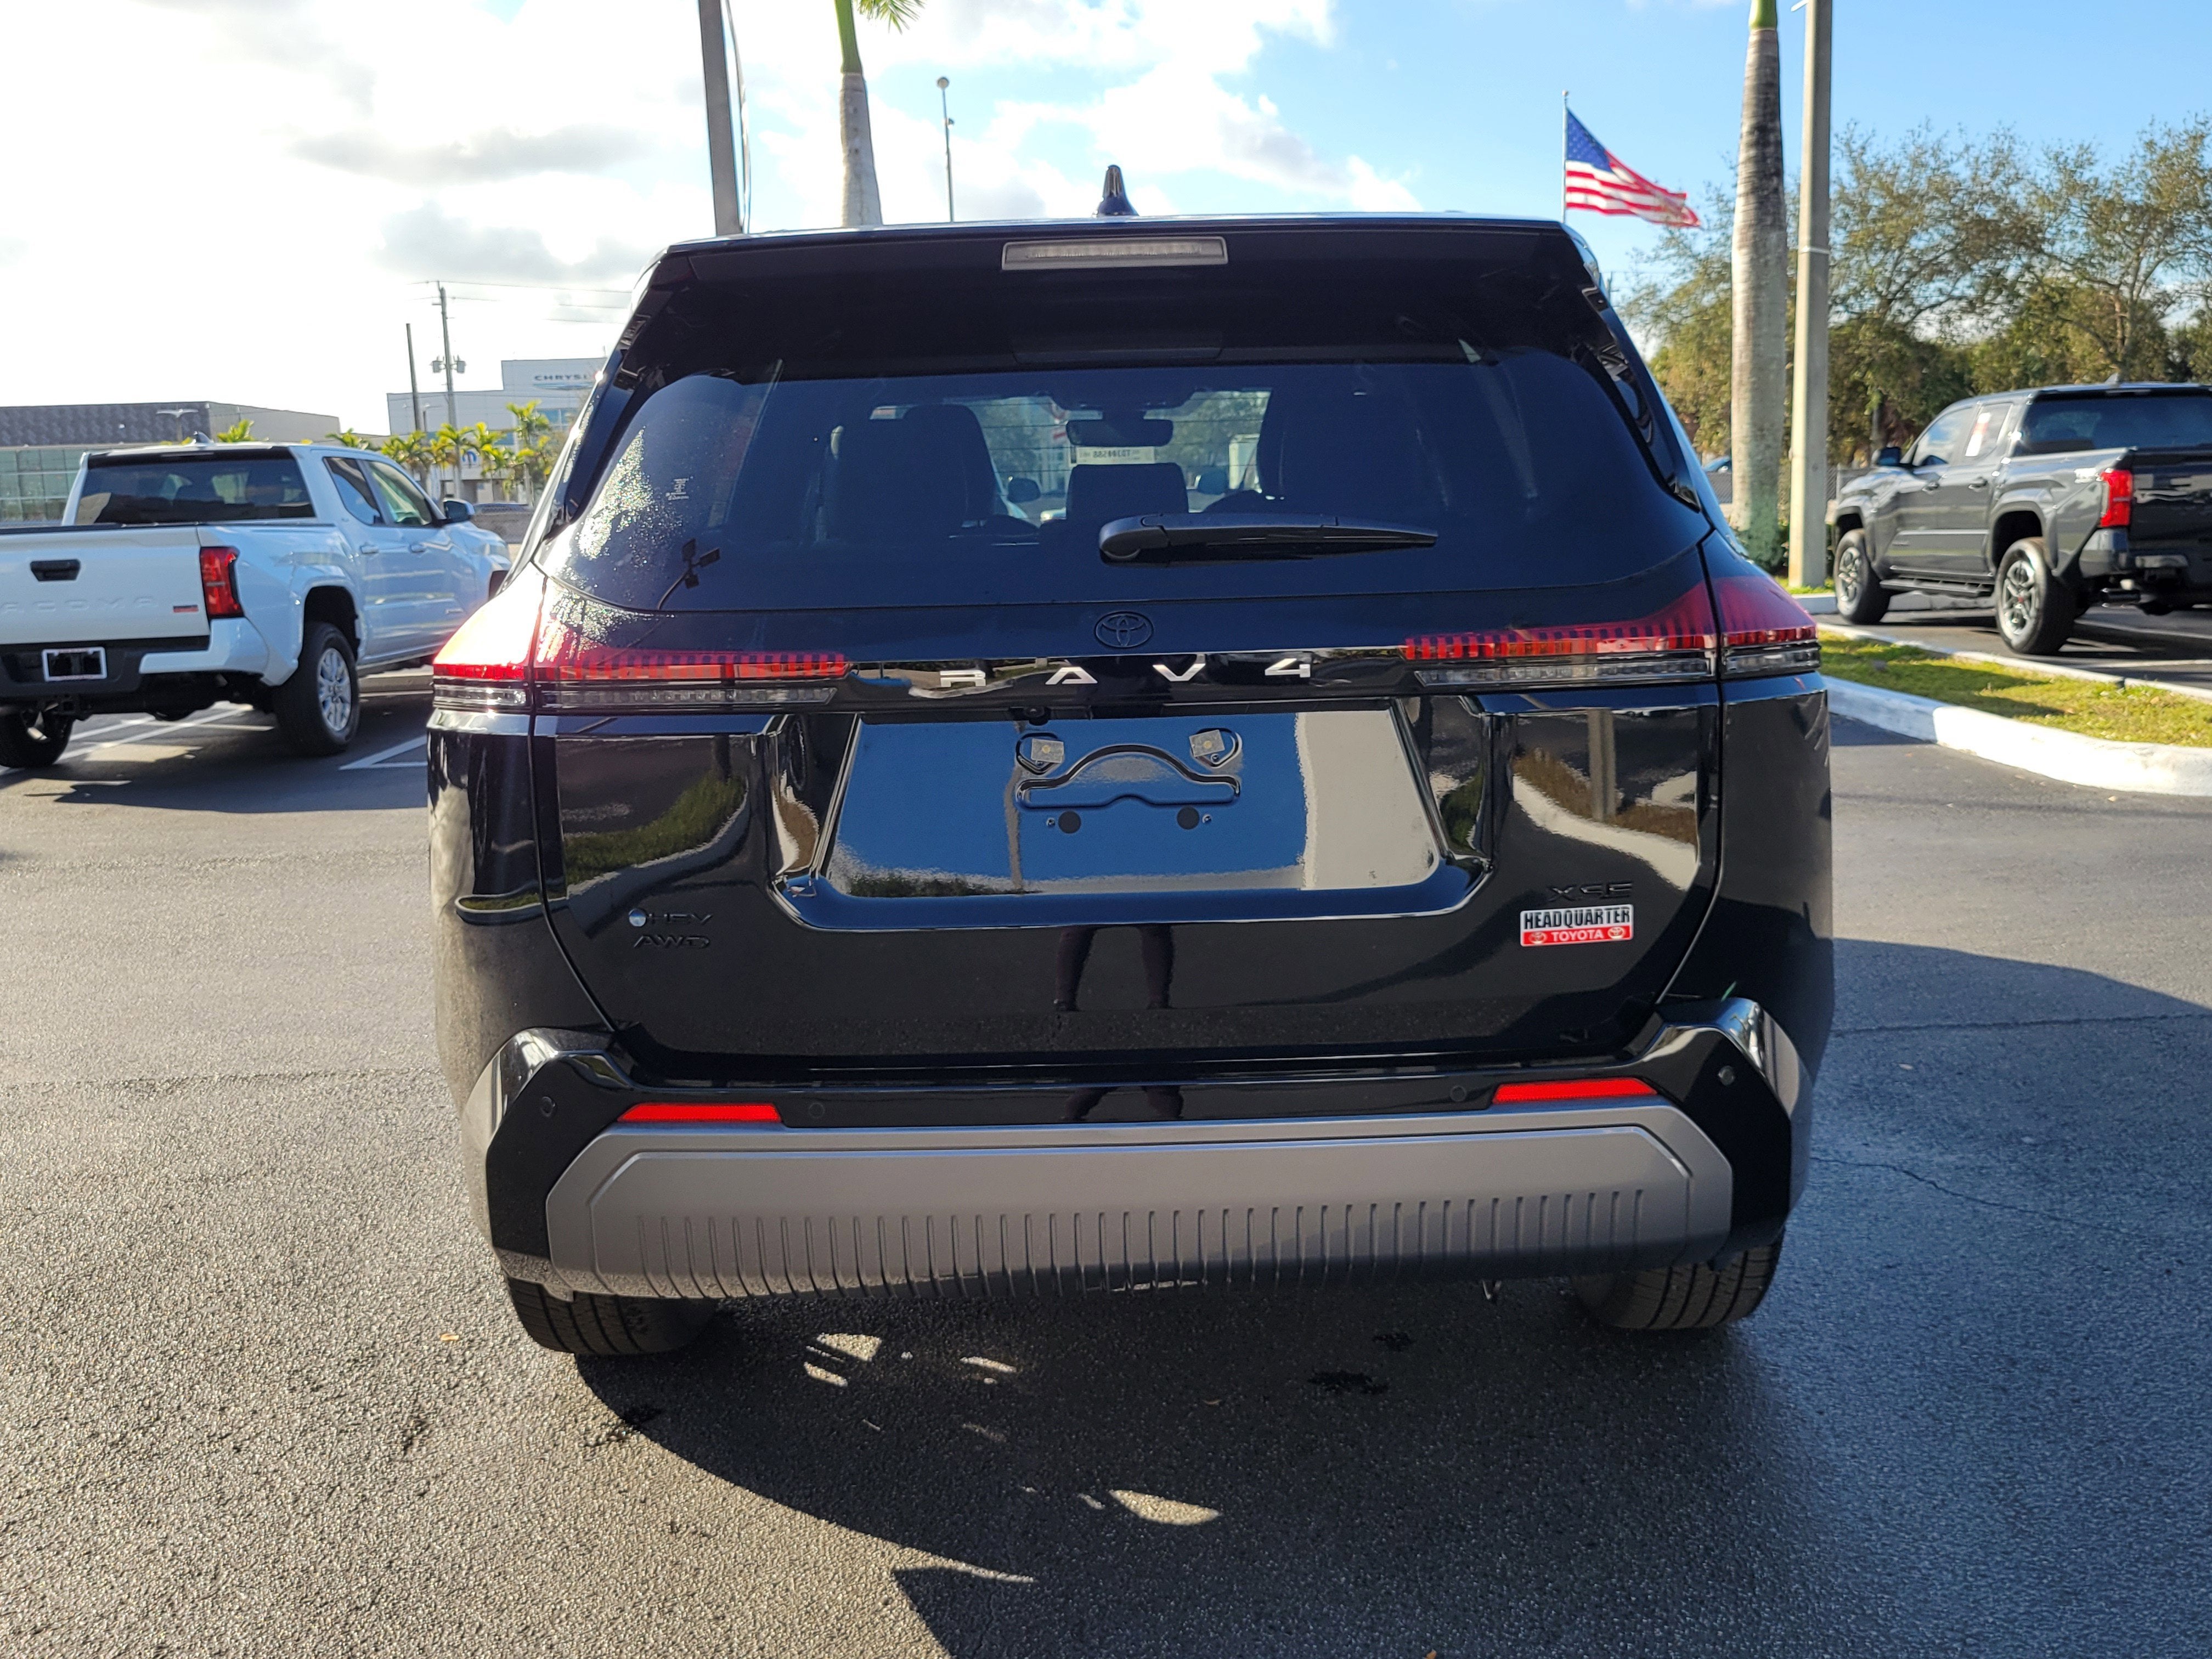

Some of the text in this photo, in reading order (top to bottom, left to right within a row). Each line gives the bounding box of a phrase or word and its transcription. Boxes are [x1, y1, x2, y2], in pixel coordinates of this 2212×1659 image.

[1, 596, 159, 614] ACOMA
[940, 658, 1311, 687] RAV4
[1547, 881, 1634, 902] XSE
[648, 913, 713, 926] HEV
[1524, 907, 1630, 929] HEADQUARTER
[633, 934, 711, 949] AWD
[1550, 929, 1604, 942] TOYOTA
